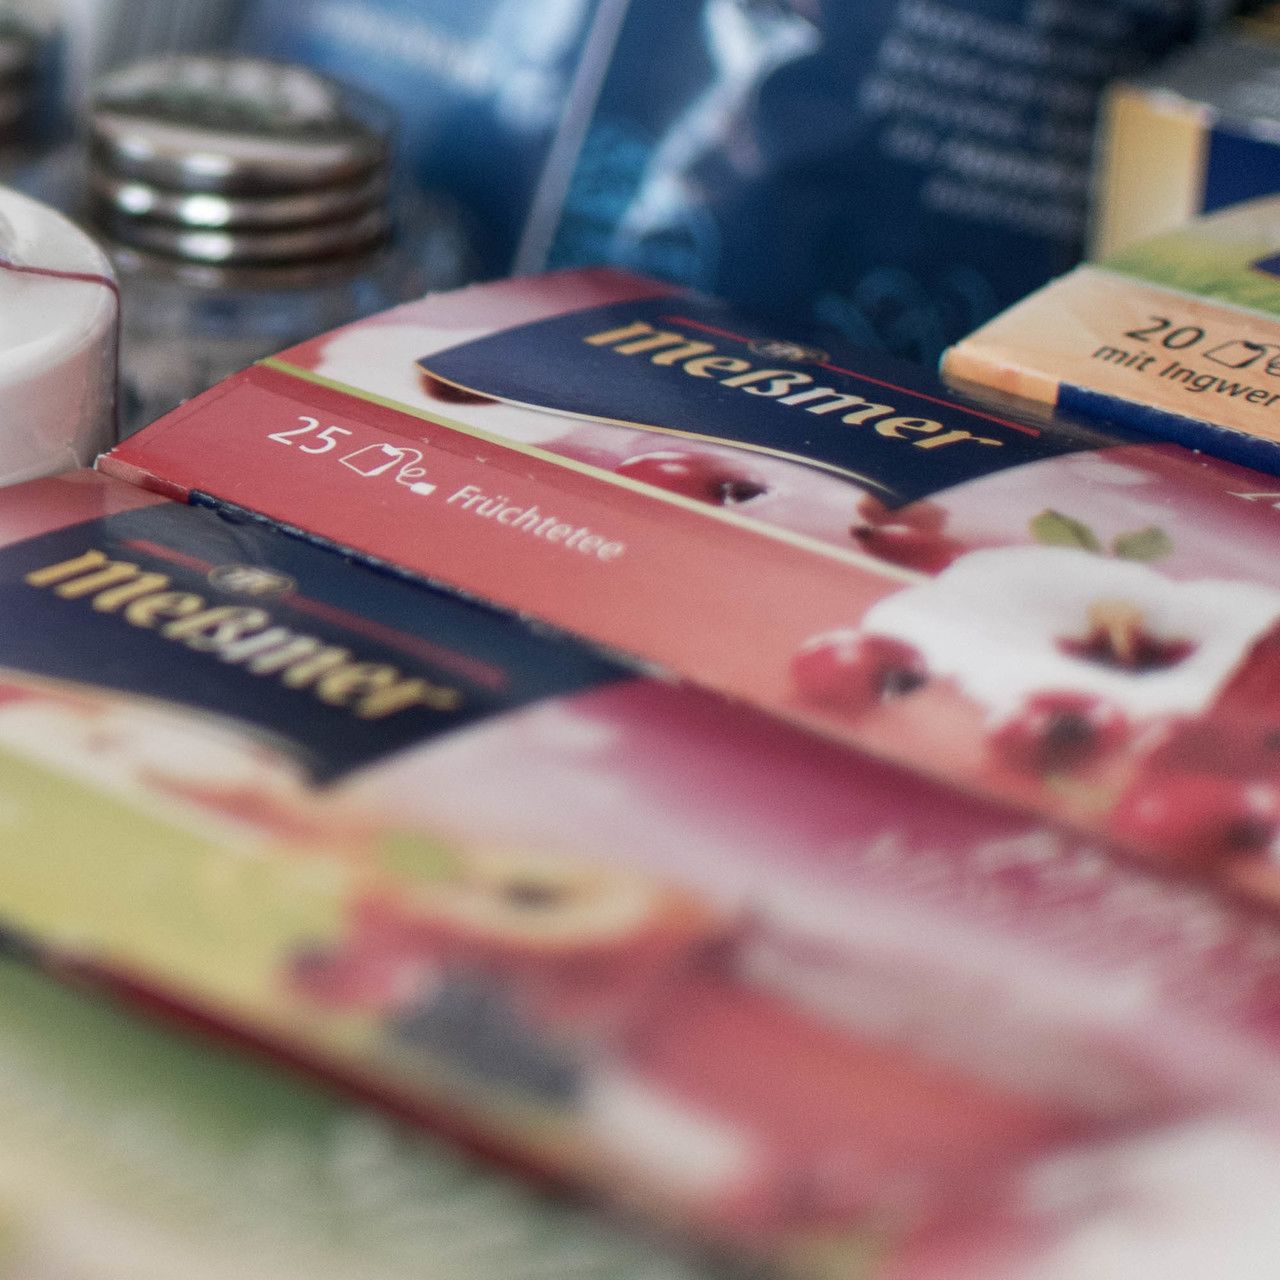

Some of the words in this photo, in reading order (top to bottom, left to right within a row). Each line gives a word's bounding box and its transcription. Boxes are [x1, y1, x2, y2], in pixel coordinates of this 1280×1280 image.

[1124, 316, 1206, 349] 20
[1092, 345, 1157, 372] mit
[1158, 361, 1280, 407] Ingwer
[267, 416, 352, 455] 25
[445, 483, 627, 563] Früchtetee
